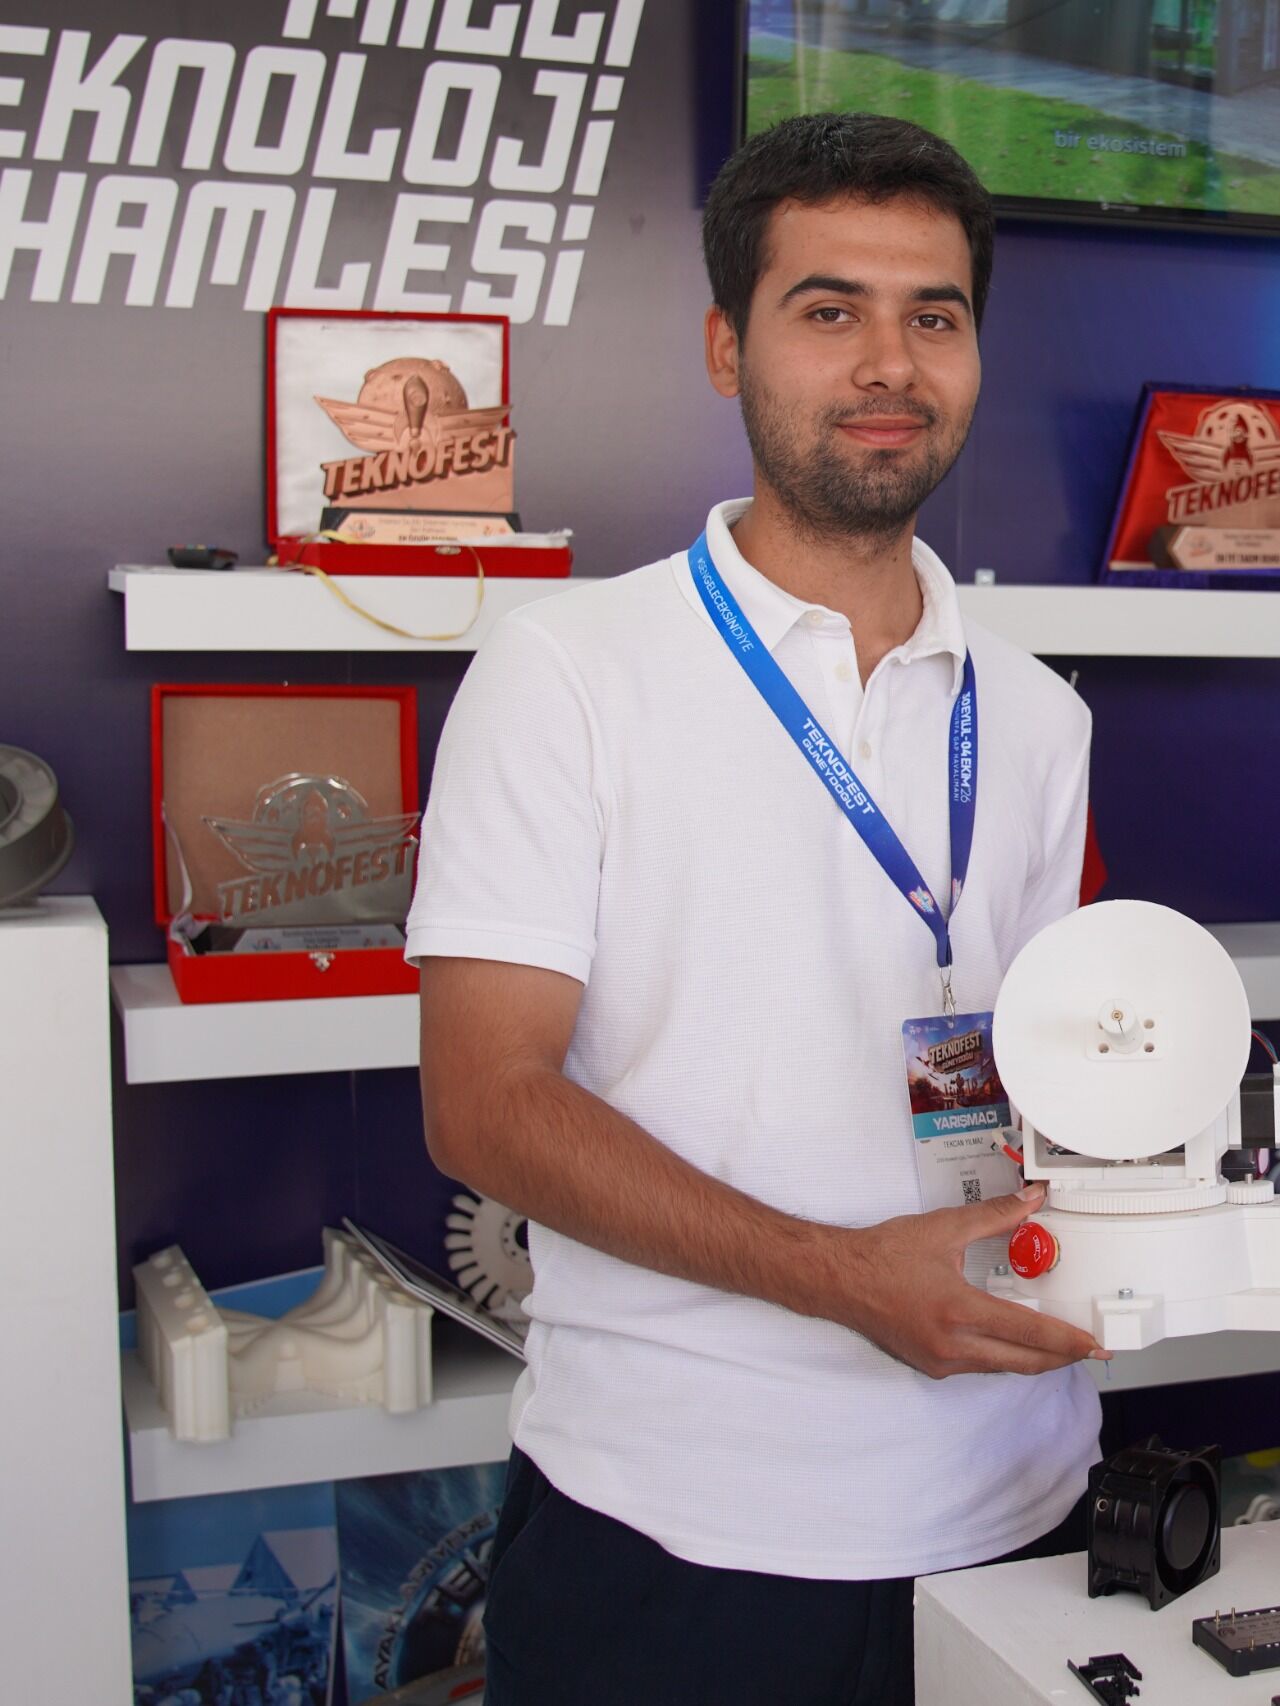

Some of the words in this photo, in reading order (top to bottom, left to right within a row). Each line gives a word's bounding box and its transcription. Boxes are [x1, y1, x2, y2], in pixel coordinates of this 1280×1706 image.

[1055, 130, 1081, 148] bir
[1087, 135, 1187, 157] ekosistem
[321, 430, 515, 499] TEKNOFEST
[803, 717, 875, 814] TEKNOFEST
[222, 842, 412, 918] TEKNOFEST
[928, 1032, 981, 1064] TEKNOFEST
[933, 1110, 998, 1130] YARIŞMACI
